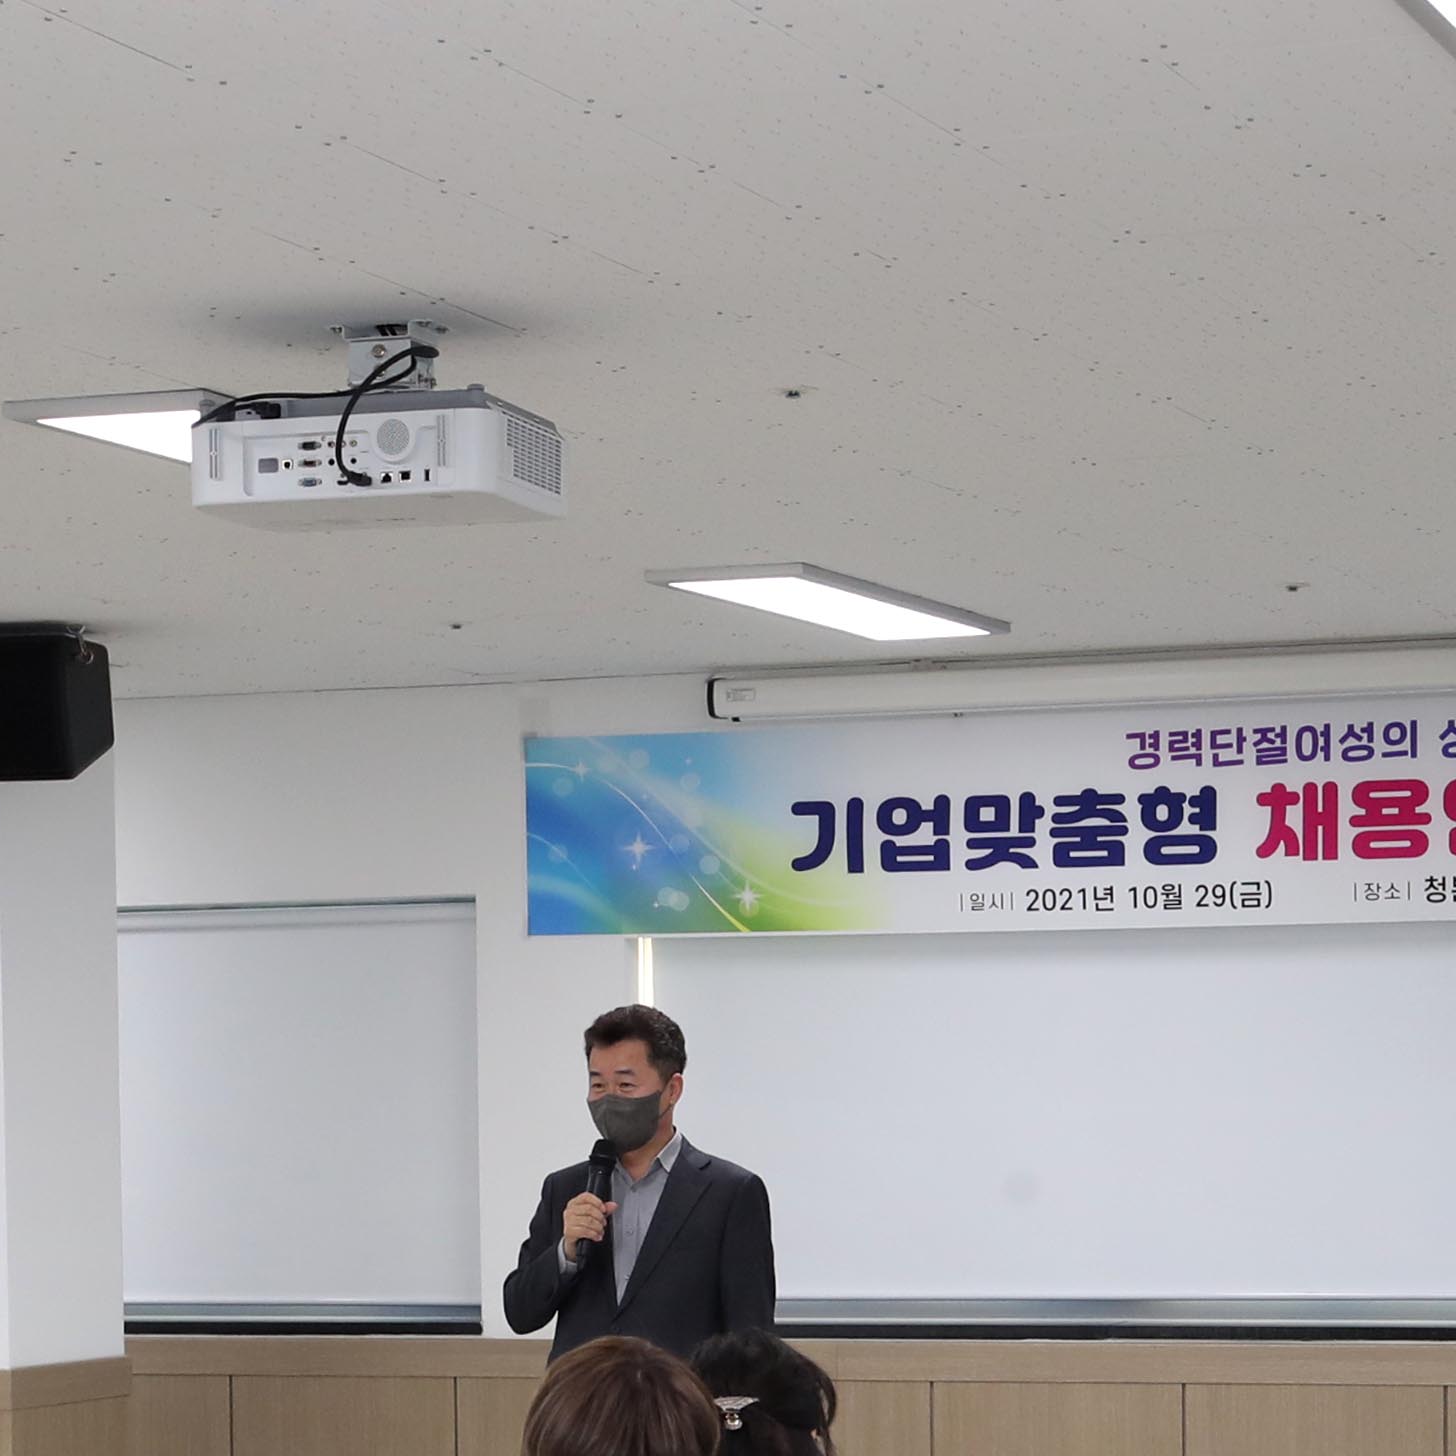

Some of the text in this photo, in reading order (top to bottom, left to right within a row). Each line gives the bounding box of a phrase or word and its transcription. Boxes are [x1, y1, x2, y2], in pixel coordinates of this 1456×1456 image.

[1125, 720, 1419, 771] 경력단절여성의
[791, 785, 1219, 874] 기업맞춤형
[1025, 886, 1115, 913] 2021년
[1127, 882, 1185, 911] 10월
[1194, 878, 1274, 911] 29(금)
